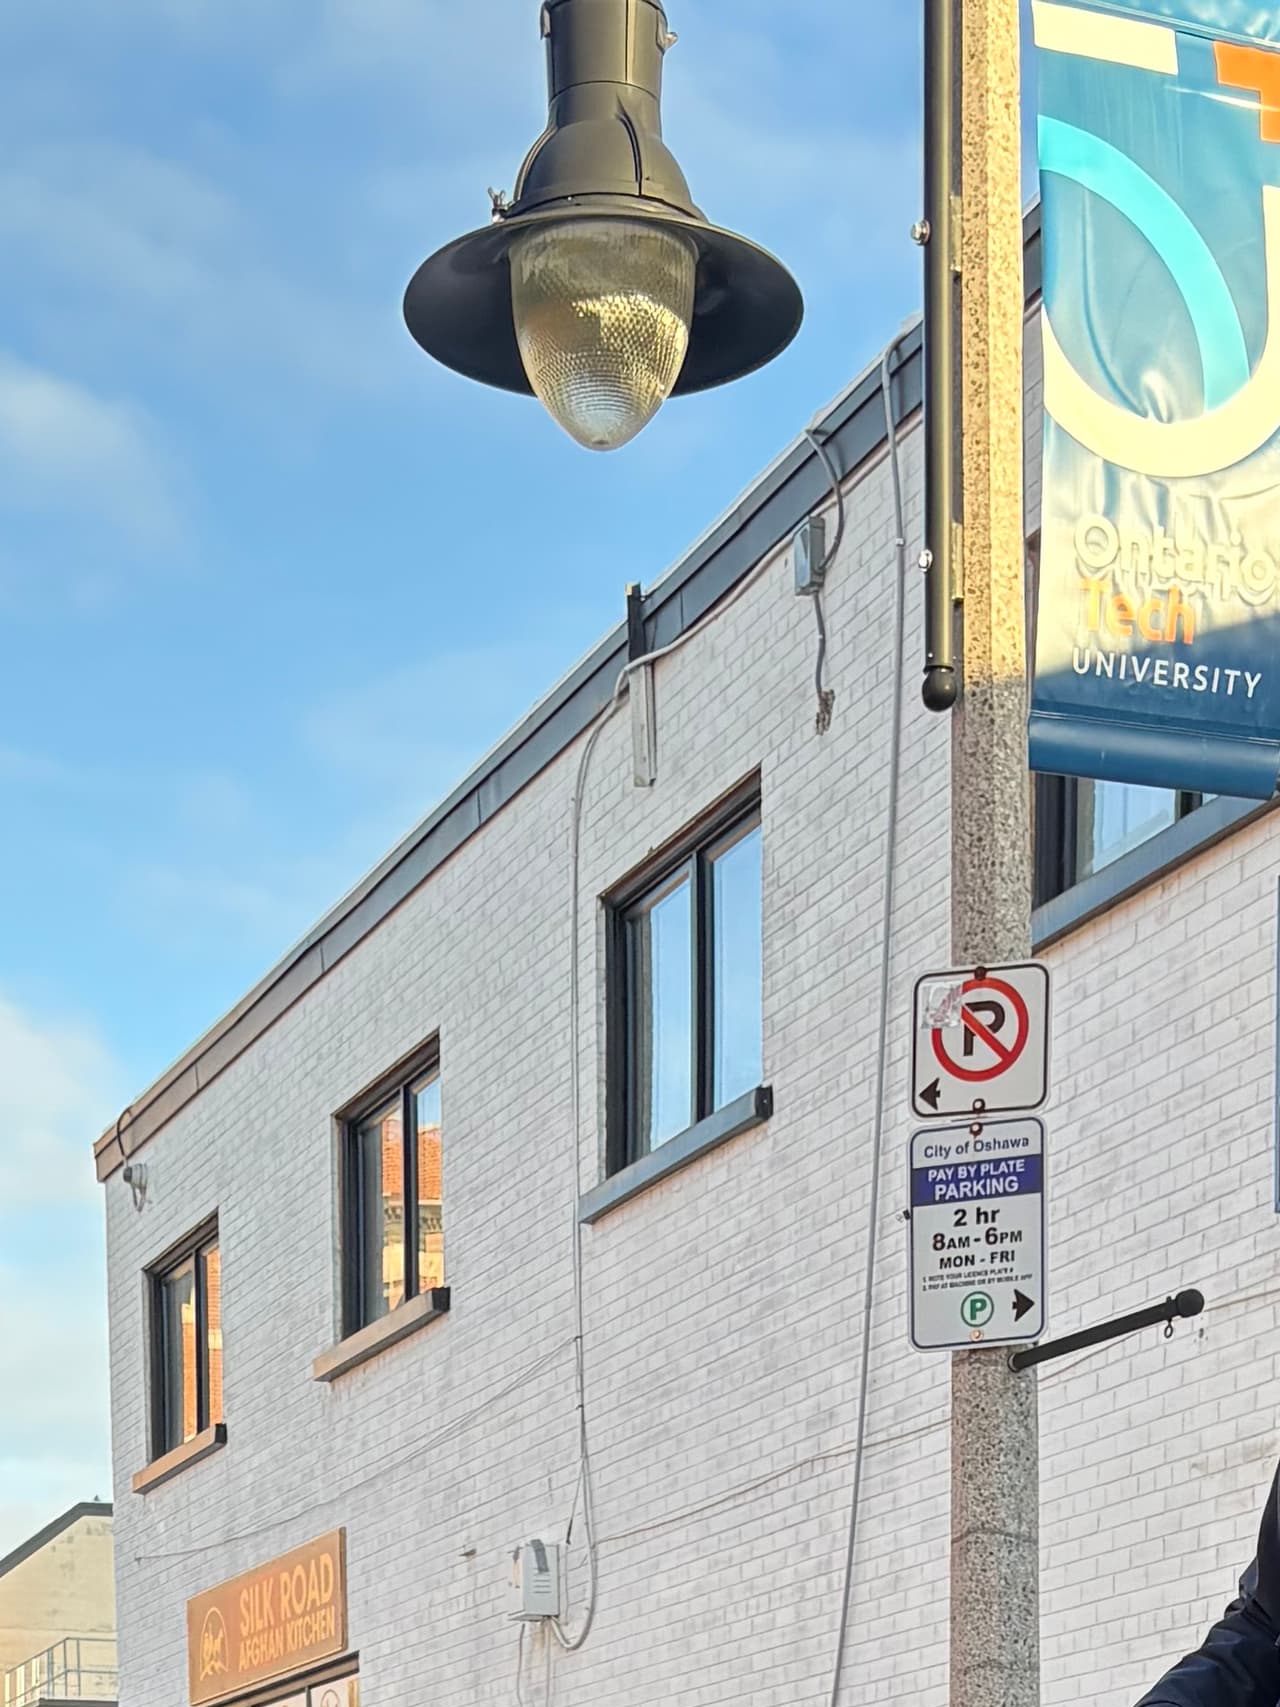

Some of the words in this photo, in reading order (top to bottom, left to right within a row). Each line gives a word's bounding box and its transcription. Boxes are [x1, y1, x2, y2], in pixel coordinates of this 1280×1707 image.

[1074, 514, 1277, 594] Ontario
[1081, 577, 1195, 645] Tech
[1073, 648, 1262, 698] UNIVERSITY
[924, 1145, 951, 1159] City
[955, 1140, 969, 1155] of
[974, 1137, 1029, 1152] Oshawa
[928, 1168, 954, 1182] PAY
[958, 1164, 977, 1179] BY
[980, 1159, 1025, 1177] PLATE
[935, 1176, 1019, 1201] PARKING
[953, 1208, 967, 1227] 2
[975, 1207, 1000, 1224] hr
[939, 1254, 975, 1270] MON
[990, 1250, 1015, 1264] FRI
[240, 1577, 274, 1637] SILK
[280, 1552, 334, 1621] ROAD
[239, 1625, 284, 1672] AFGHAN
[286, 1605, 335, 1654] KITCHEN
